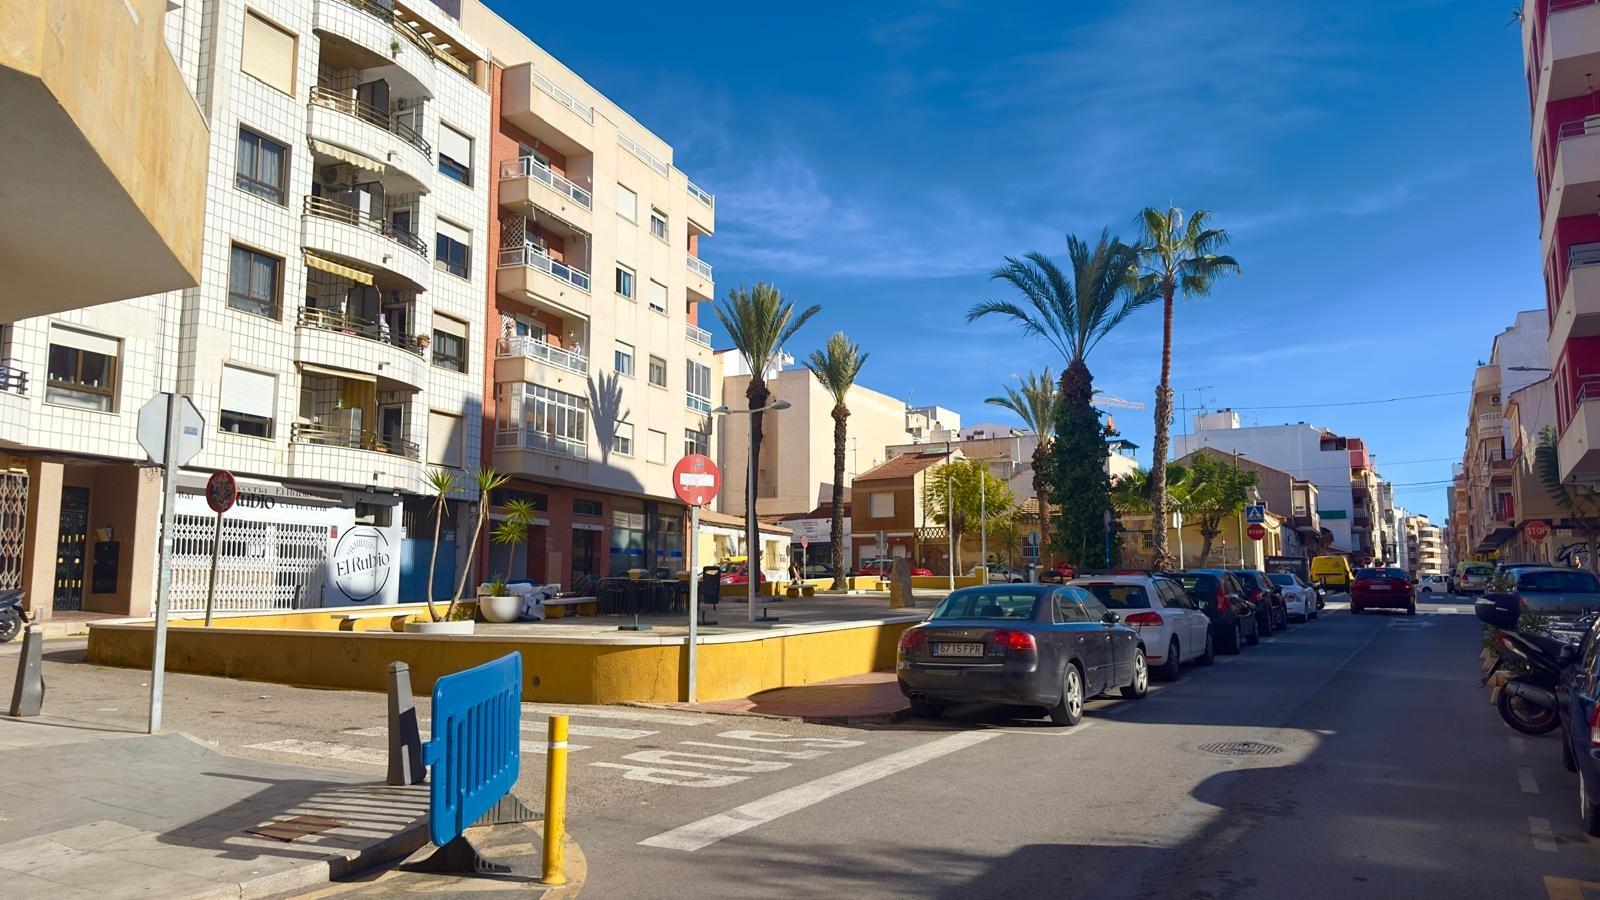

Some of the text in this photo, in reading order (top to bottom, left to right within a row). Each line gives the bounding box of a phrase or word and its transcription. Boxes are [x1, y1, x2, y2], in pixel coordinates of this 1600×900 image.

[1526, 526, 1548, 535] STOP
[336, 559, 350, 577] El
[352, 552, 390, 573] Rubio
[940, 644, 981, 653] 6715 FPR
[589, 730, 866, 788] STOP
